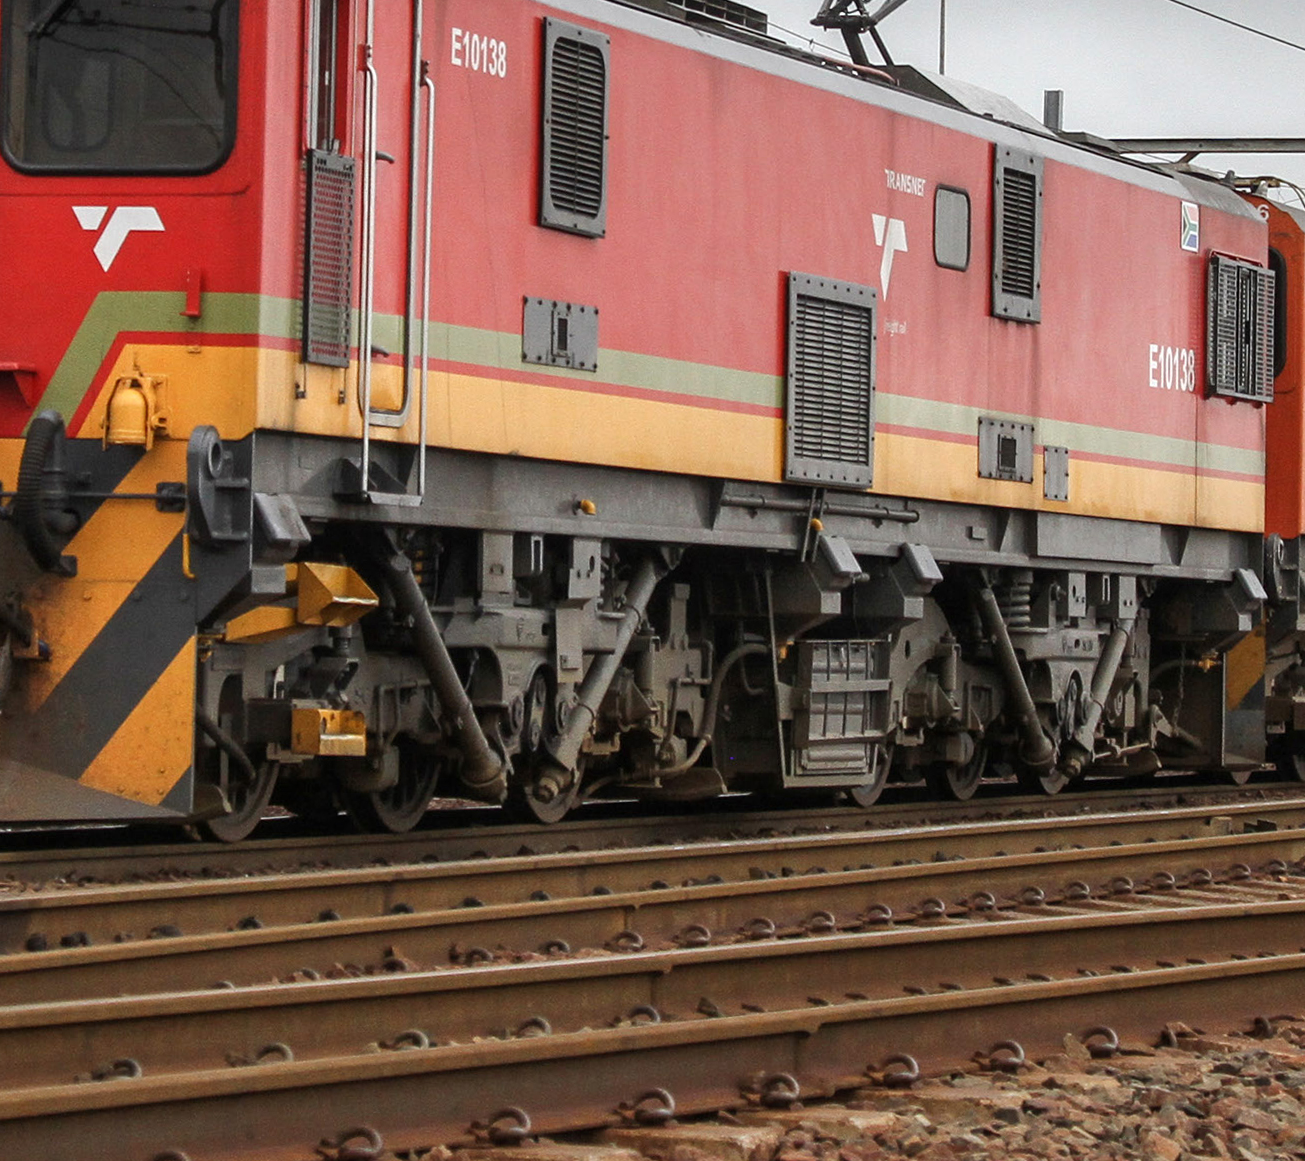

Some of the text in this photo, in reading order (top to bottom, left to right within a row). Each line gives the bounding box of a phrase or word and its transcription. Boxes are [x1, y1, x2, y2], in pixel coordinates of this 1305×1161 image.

[451, 26, 507, 78] E10138
[884, 168, 927, 198] TRANSNET
[1149, 343, 1195, 392] E10138
